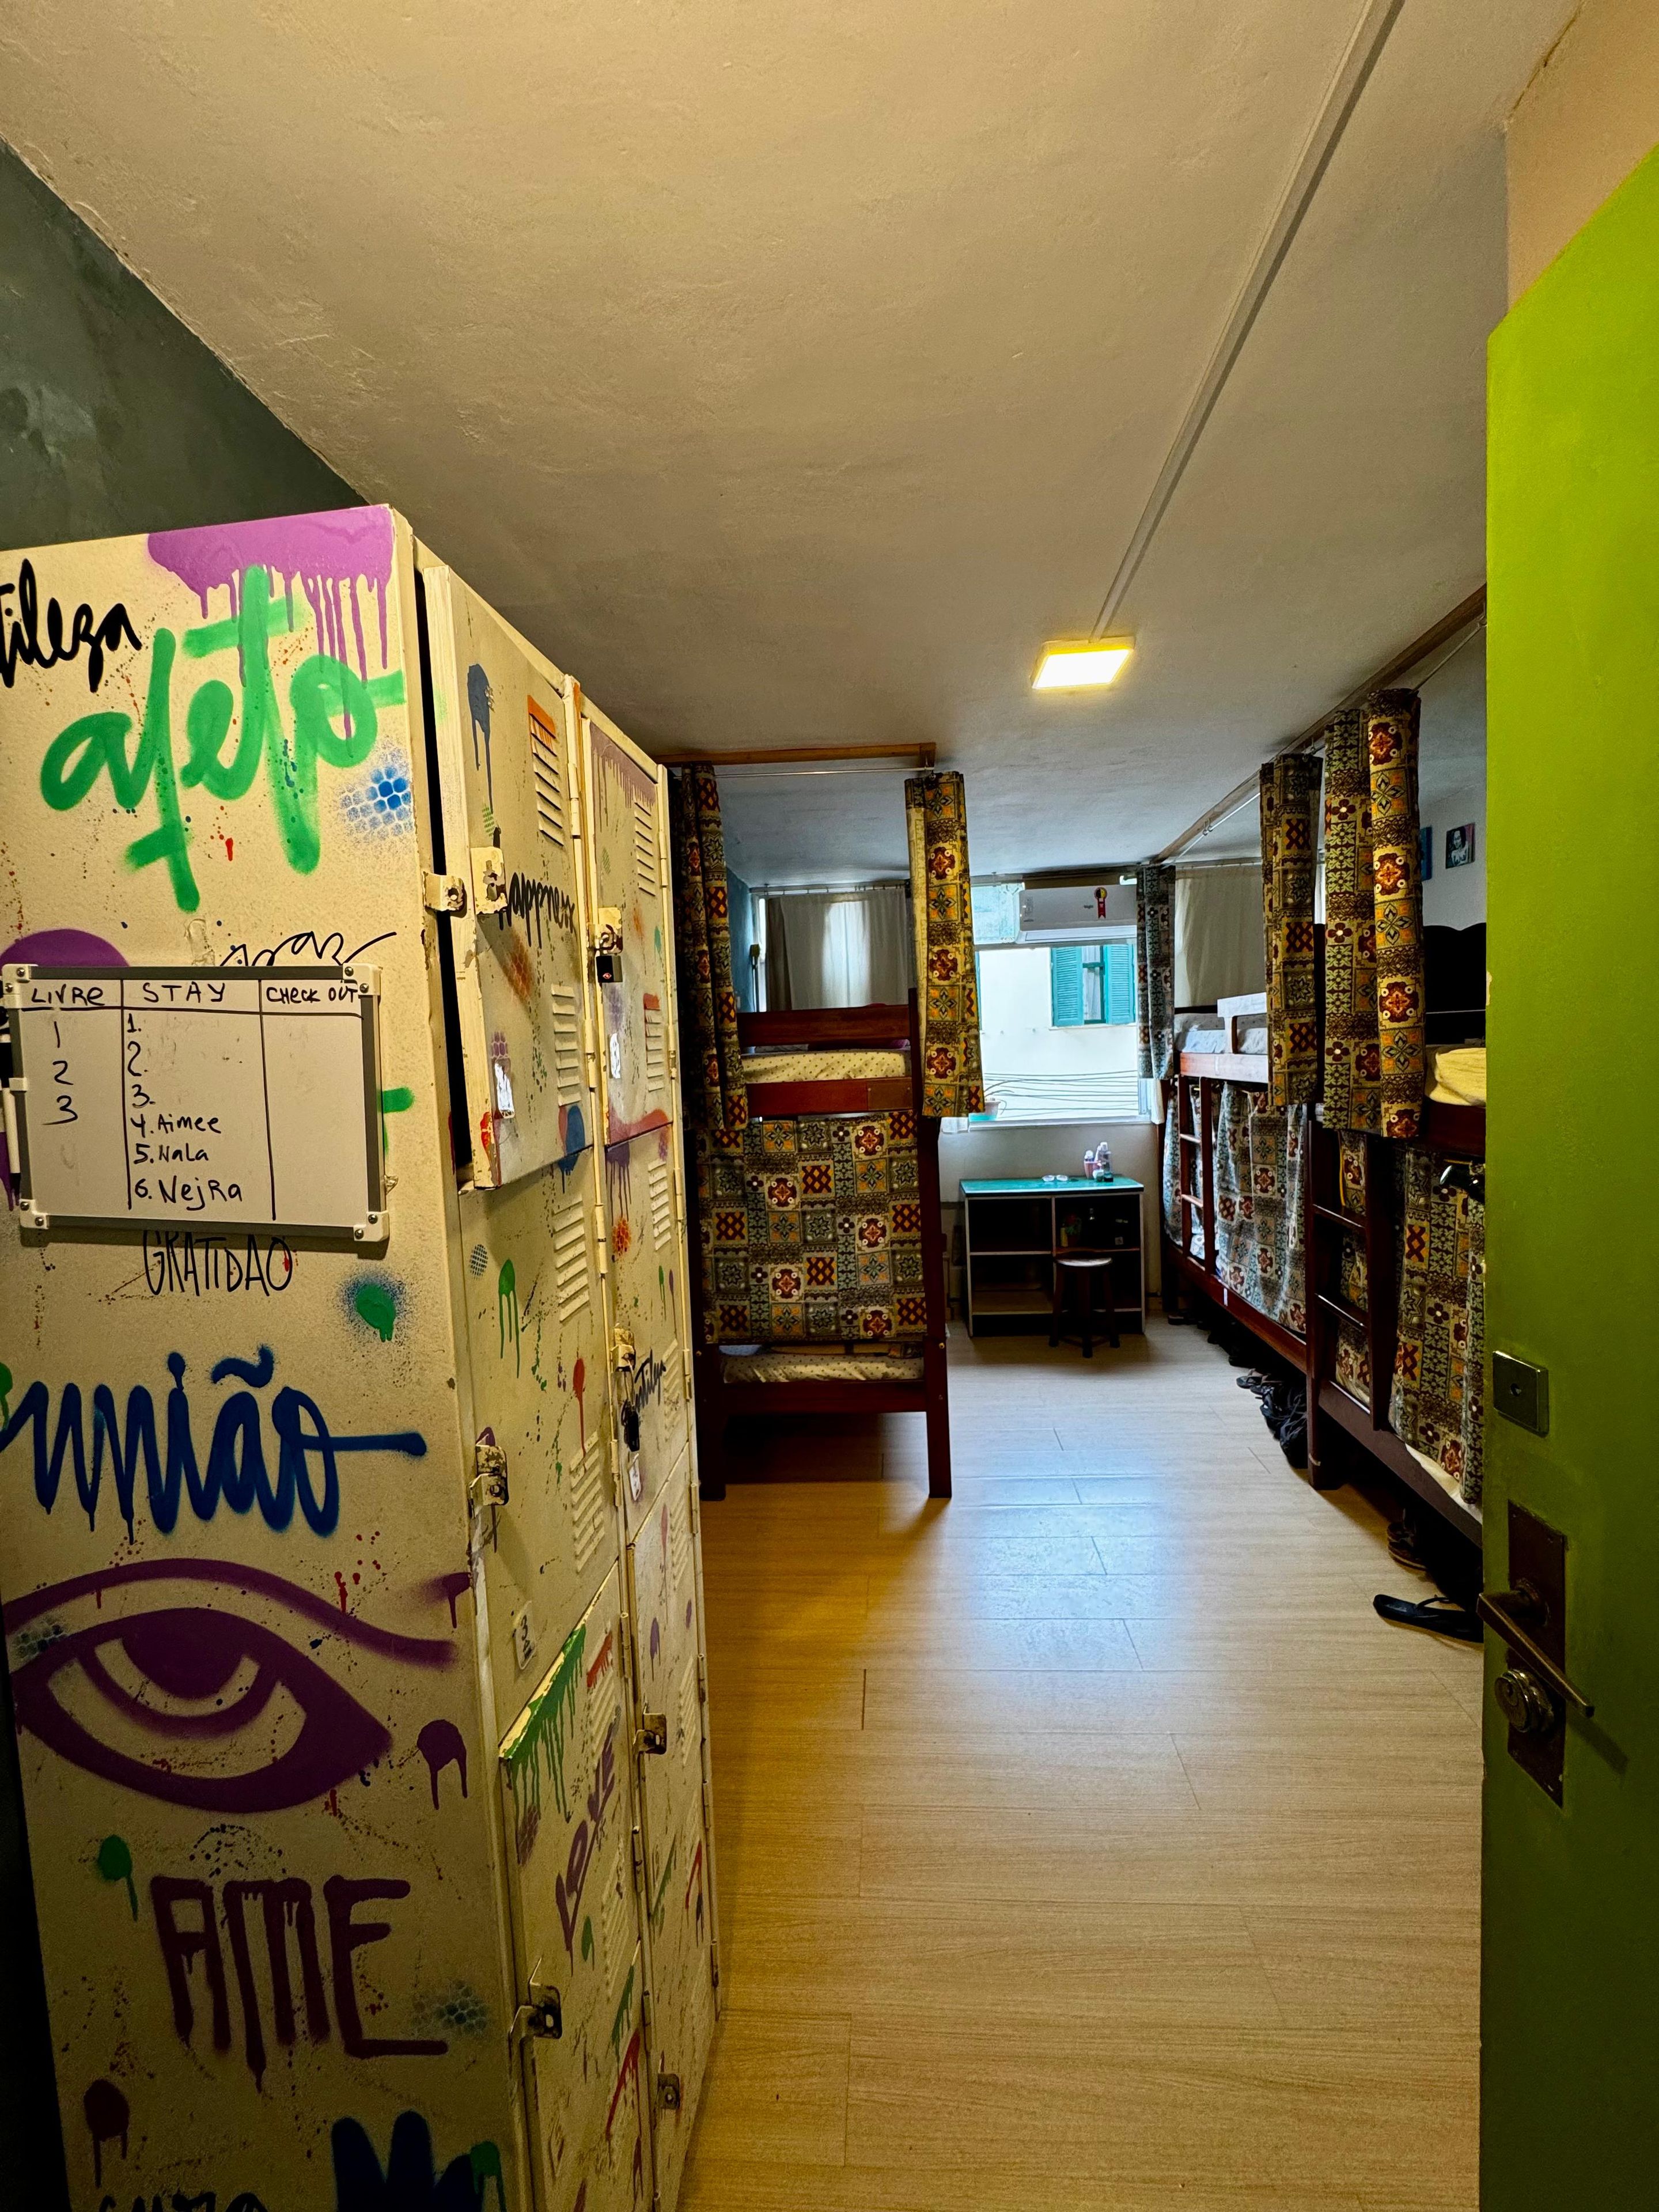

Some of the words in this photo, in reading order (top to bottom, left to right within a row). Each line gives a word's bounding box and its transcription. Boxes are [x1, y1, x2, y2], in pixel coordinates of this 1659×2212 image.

[142, 981, 225, 1003] STAY
[328, 985, 358, 1003] OUT
[53, 1021, 61, 1048] 1
[127, 1013, 142, 1033] 1.
[127, 1040, 148, 1077] 2.
[52, 1060, 74, 1085] 2
[41, 1095, 78, 1126] 3
[149, 1873, 449, 2074] AME
